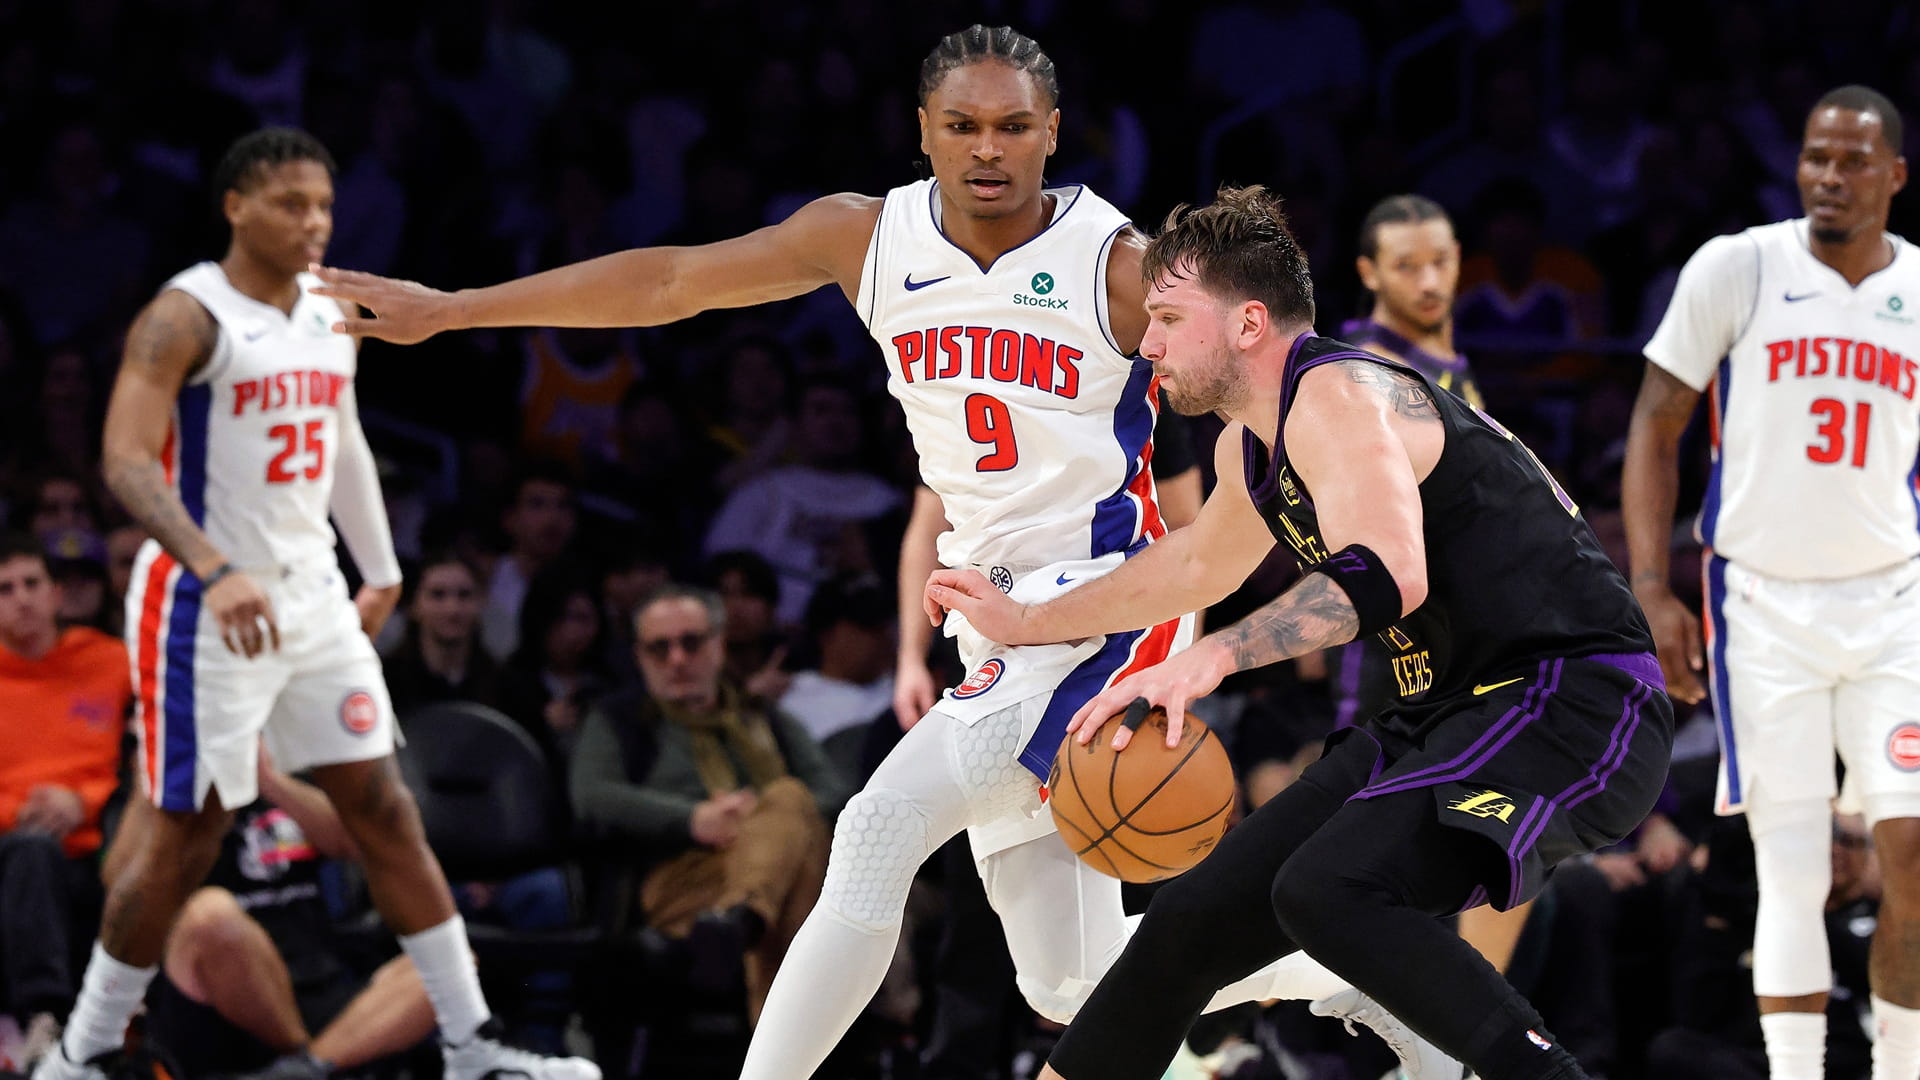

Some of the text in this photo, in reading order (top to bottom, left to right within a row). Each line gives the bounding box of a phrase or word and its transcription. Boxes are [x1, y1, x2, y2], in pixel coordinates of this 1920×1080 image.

[1013, 293, 1069, 311] StockX
[232, 370, 347, 416] PISTON
[891, 325, 1084, 400] PISTONS
[1765, 337, 1919, 401] PISTONS
[265, 419, 324, 485] 25
[964, 392, 1019, 473] 9
[1805, 397, 1872, 469] 31
[1392, 650, 1433, 697] KERS
[1447, 789, 1516, 824] LA
